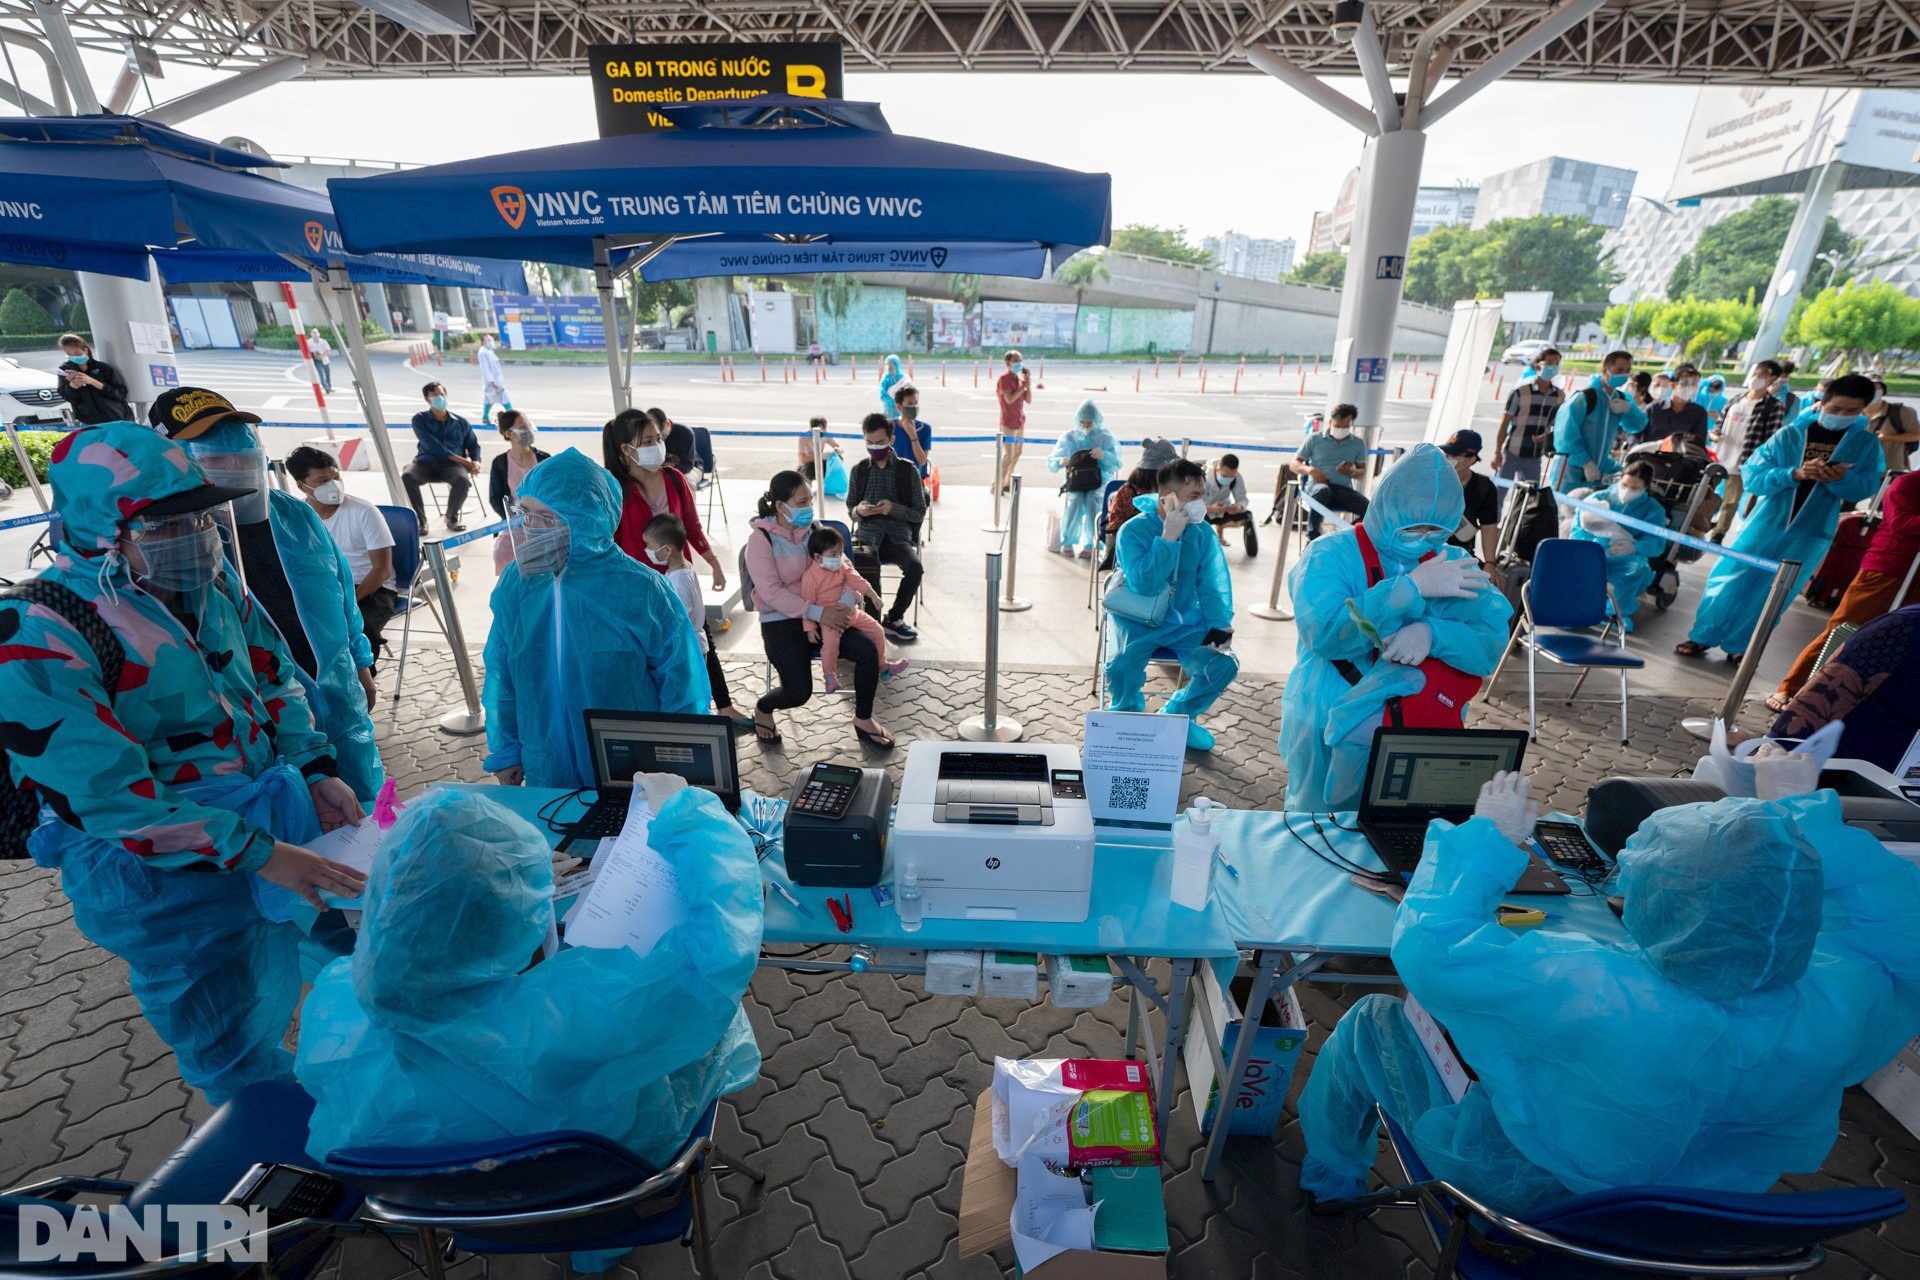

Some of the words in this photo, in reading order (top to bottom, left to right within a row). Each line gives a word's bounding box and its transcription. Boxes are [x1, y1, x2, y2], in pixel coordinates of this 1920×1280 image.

[606, 61, 630, 78] GA
[635, 60, 652, 78] ĐI
[656, 59, 717, 78] TRONG
[721, 55, 771, 77] NƯỚC
[786, 64, 826, 99] B
[613, 87, 682, 103] Domestic
[648, 112, 674, 127] VIE
[526, 190, 601, 217] VNVC
[608, 195, 680, 216] TRUNG
[684, 191, 728, 215] TÂM
[733, 190, 781, 214] TIÊM
[787, 191, 861, 216] CHỦNG
[866, 196, 922, 218] VNVC
[536, 218, 563, 227] Vietnam
[564, 217, 590, 226] Vaccine
[591, 216, 605, 225] JSC
[323, 229, 343, 249] VN
[455, 533, 472, 545] TIA
[986, 857, 1001, 870] hp
